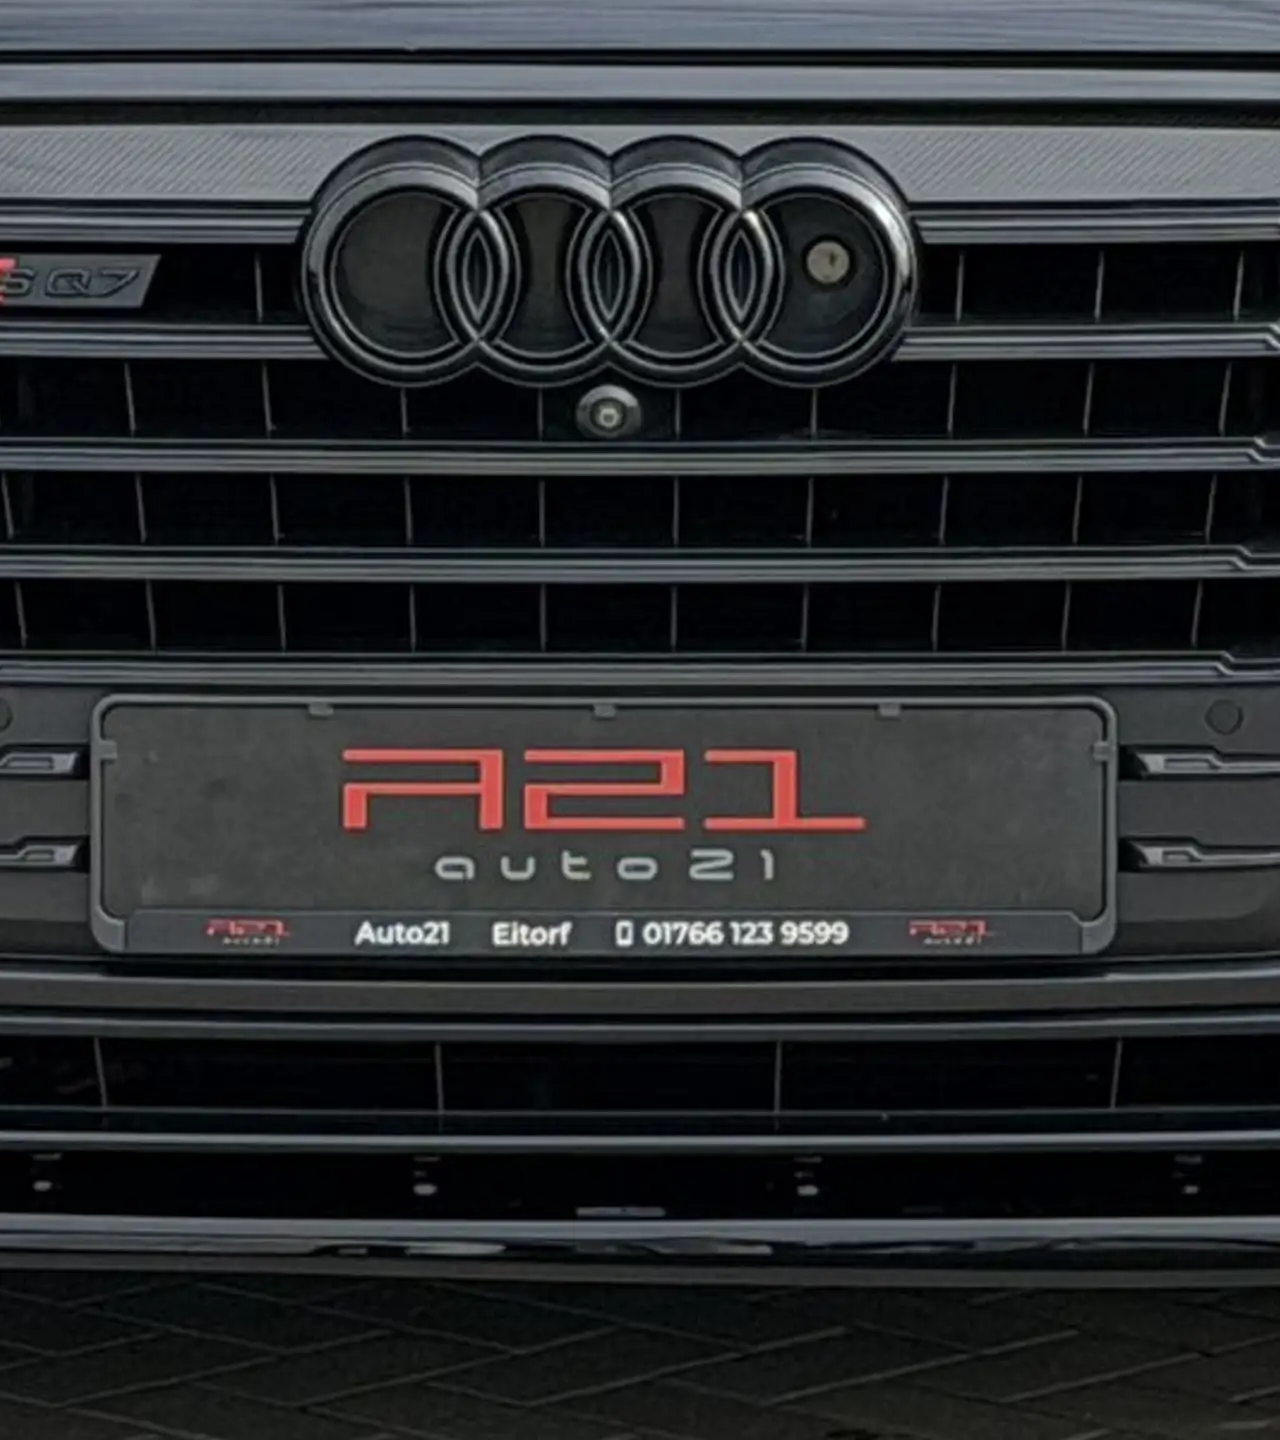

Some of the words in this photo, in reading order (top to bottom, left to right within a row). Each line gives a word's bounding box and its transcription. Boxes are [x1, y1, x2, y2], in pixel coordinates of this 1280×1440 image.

[342, 748, 867, 830] A21
[354, 920, 450, 946] Auto21
[492, 920, 573, 946] Eitorf
[642, 920, 724, 946] 01766
[729, 920, 774, 946] 123
[780, 920, 850, 946] 9599
